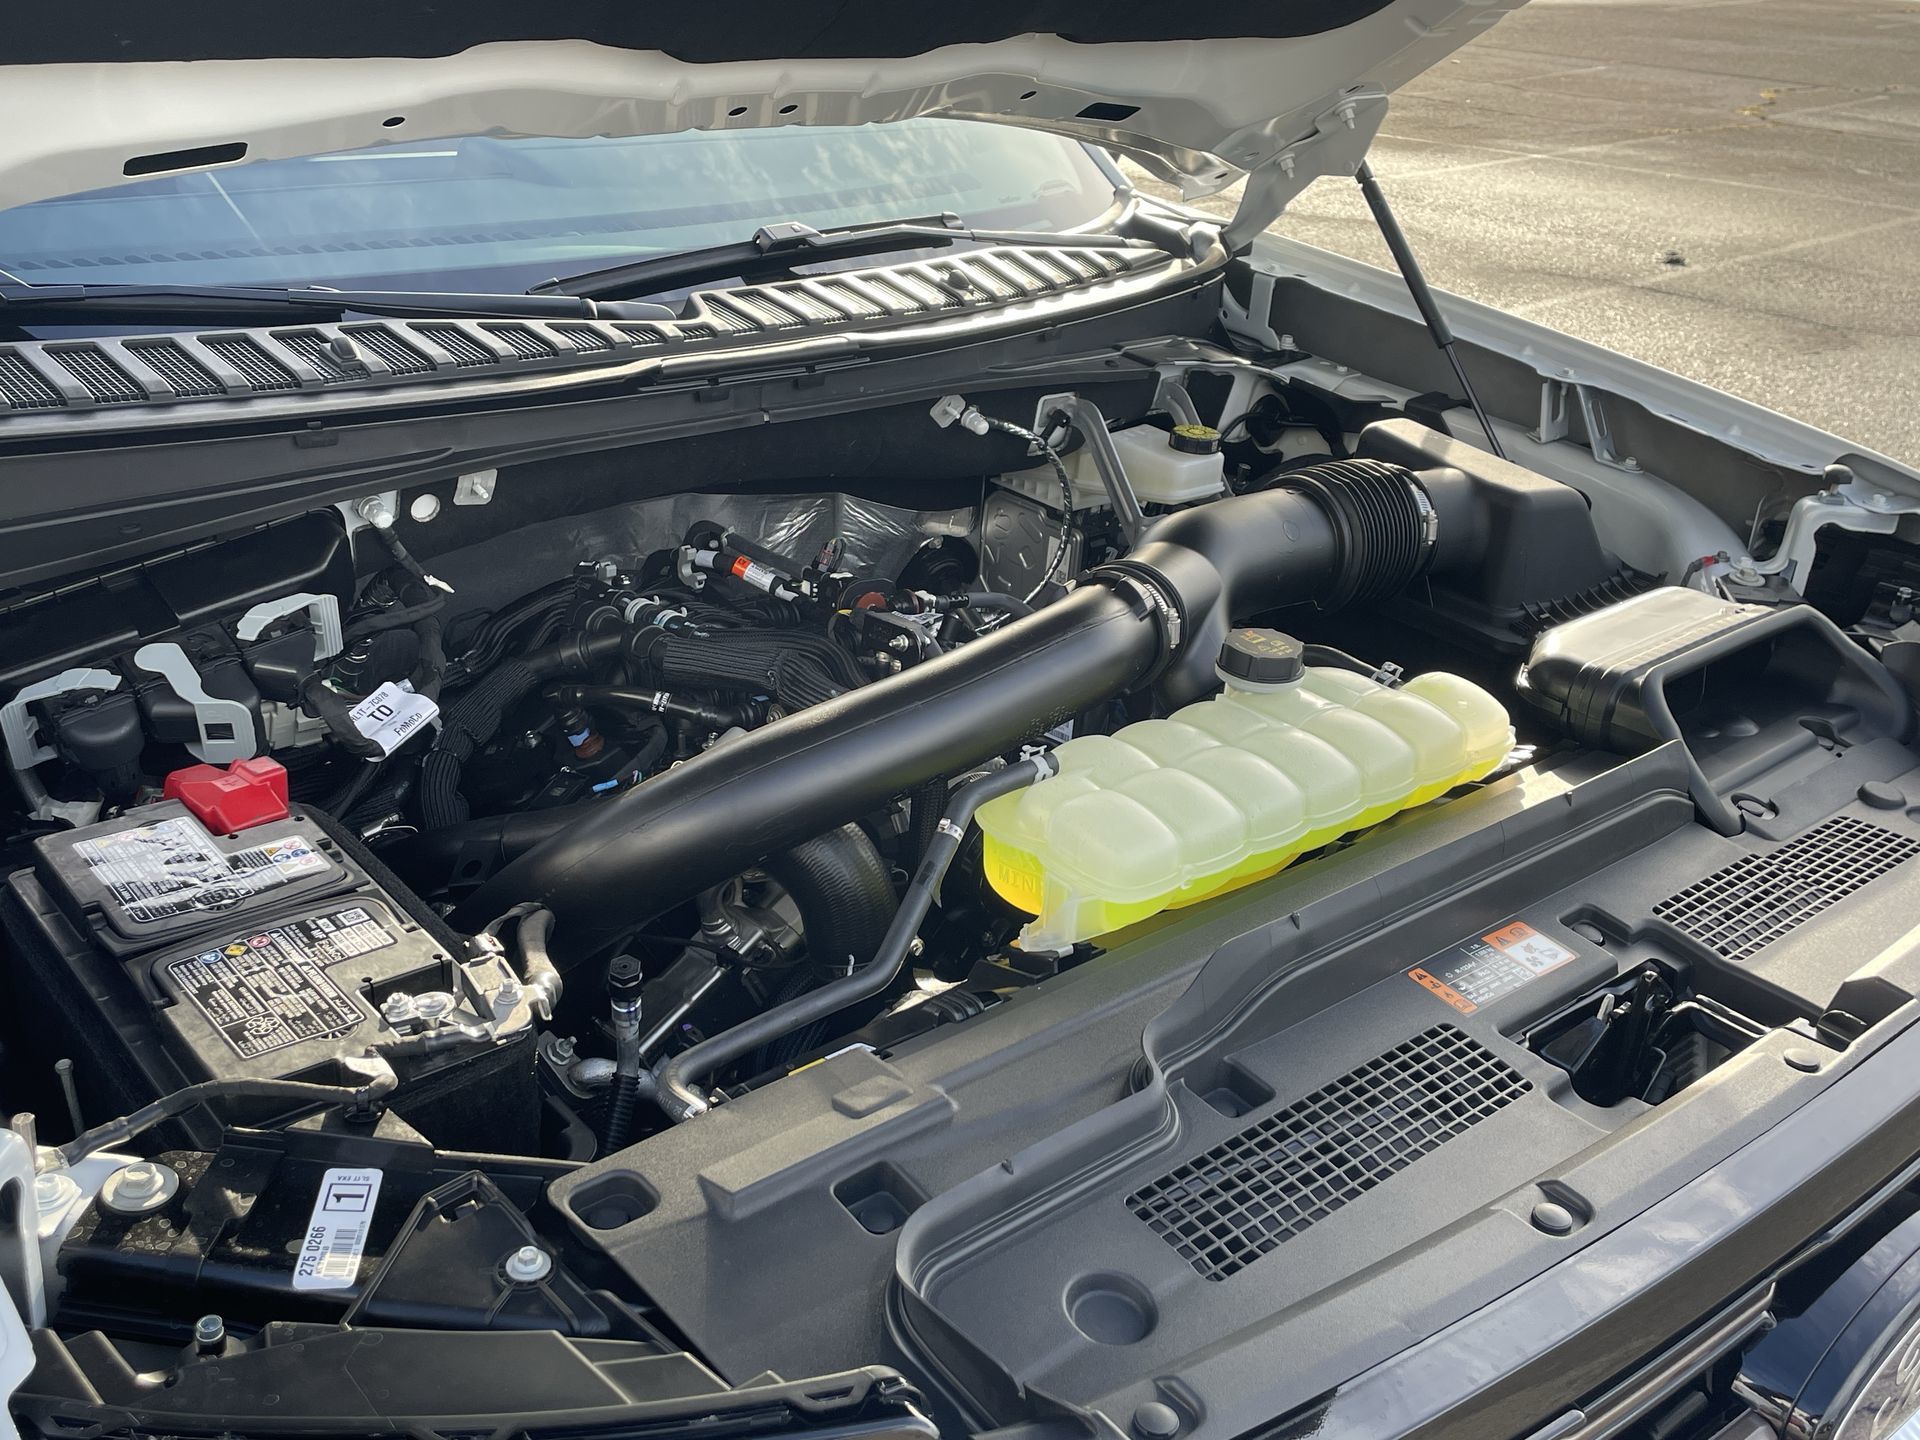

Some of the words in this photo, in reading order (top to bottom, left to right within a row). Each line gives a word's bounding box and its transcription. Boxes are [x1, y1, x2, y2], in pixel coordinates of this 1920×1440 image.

[998, 864, 1036, 893] MIN
[332, 1193, 365, 1203] 1
[306, 1226, 326, 1252] 0266
[298, 1255, 317, 1276] 275
